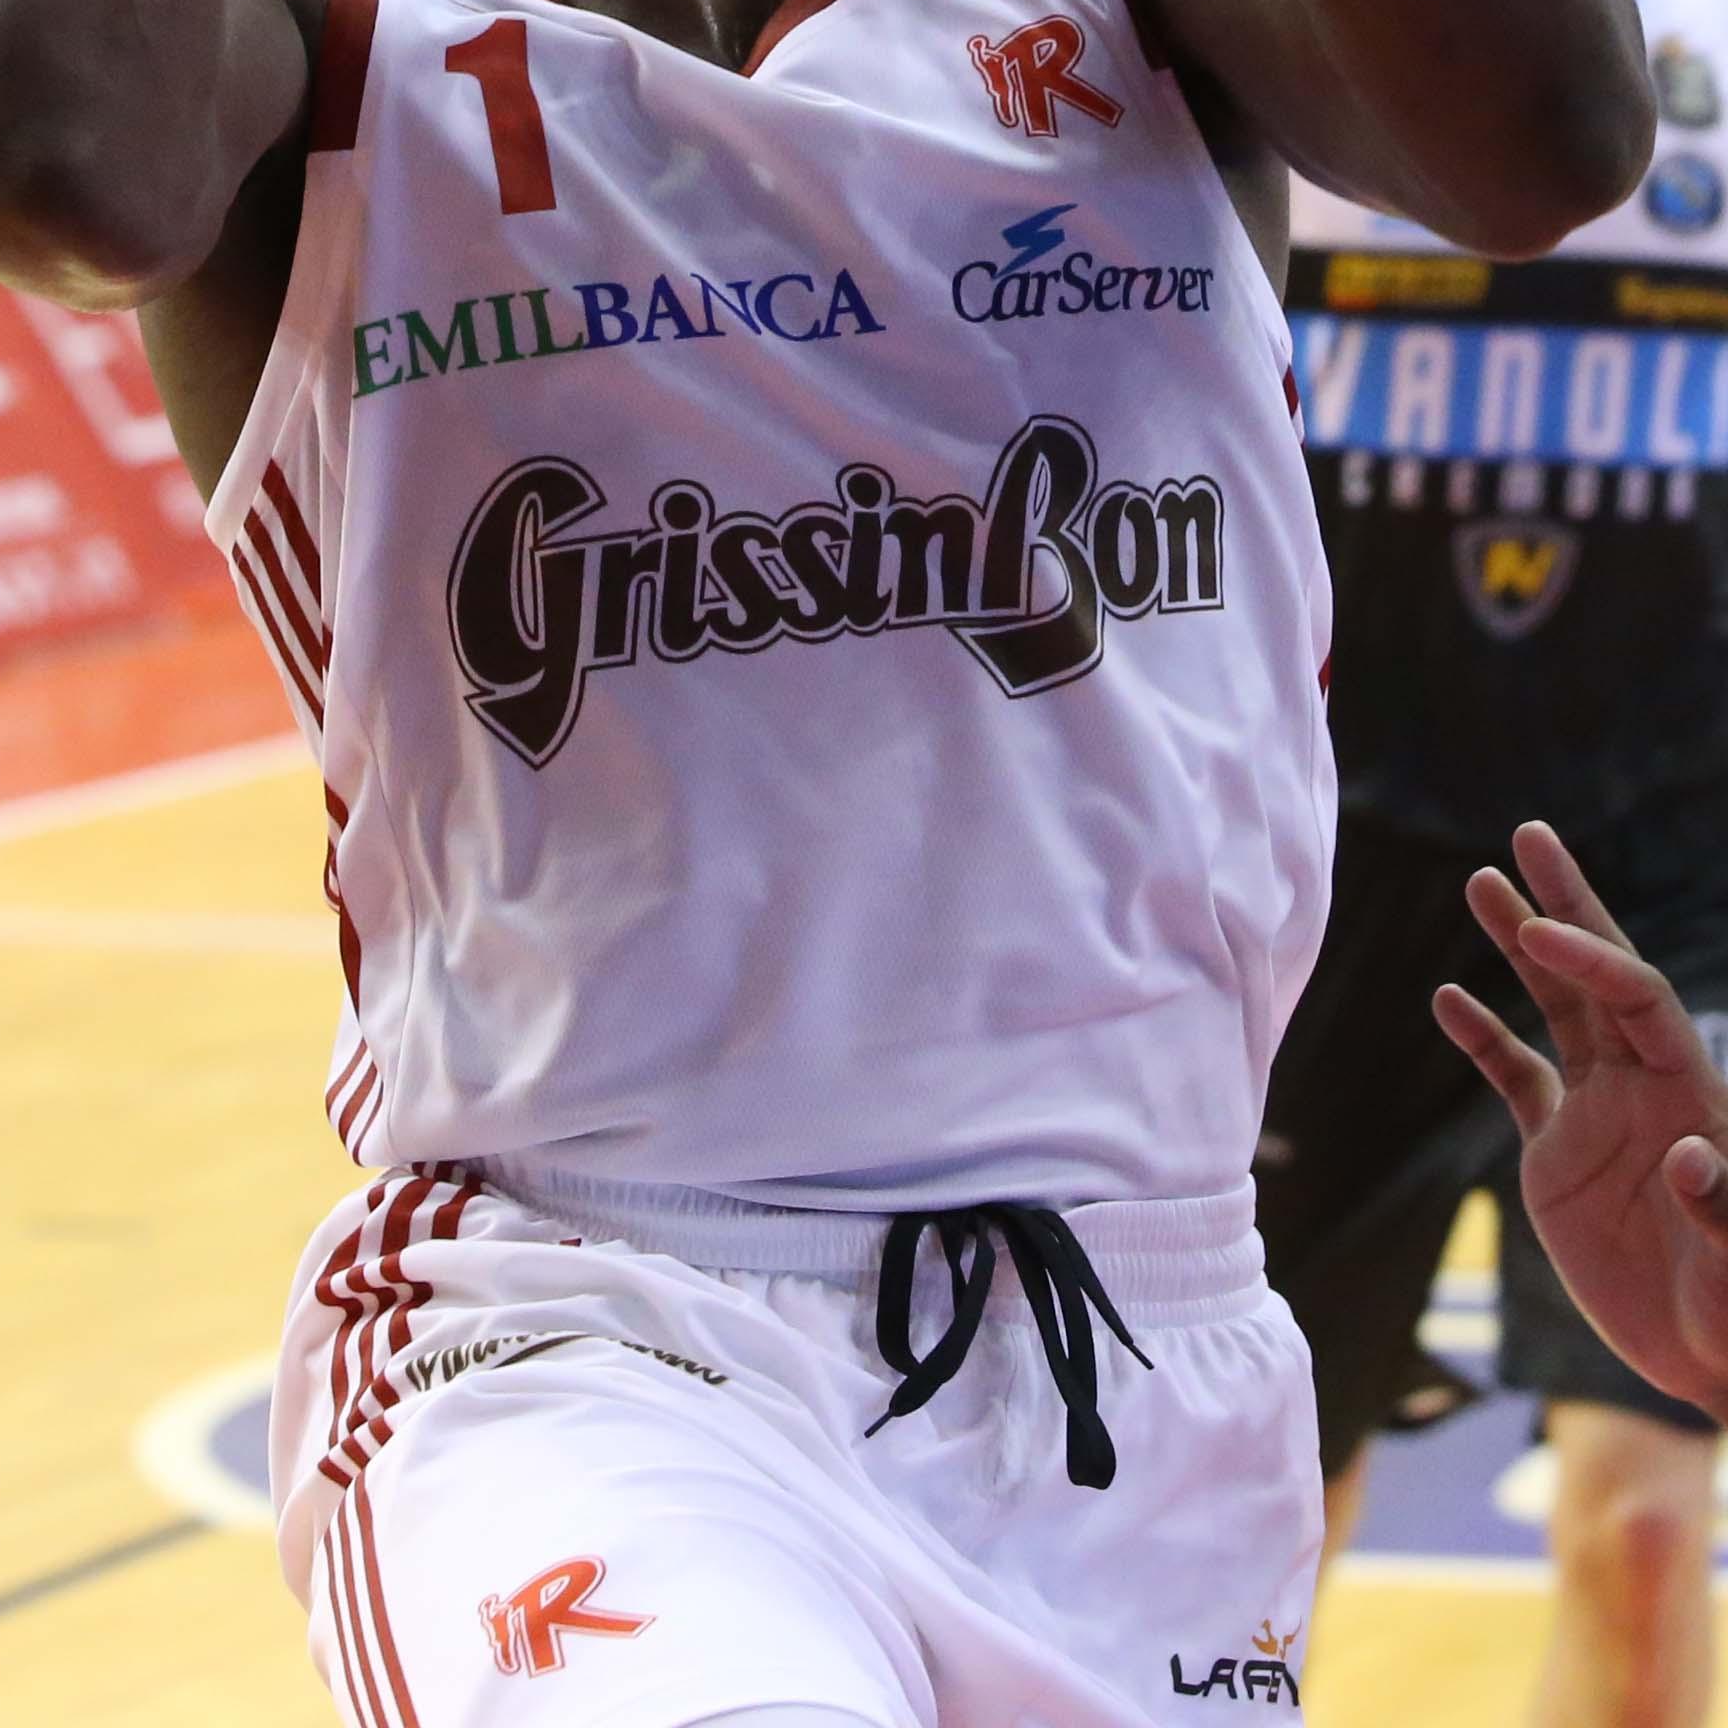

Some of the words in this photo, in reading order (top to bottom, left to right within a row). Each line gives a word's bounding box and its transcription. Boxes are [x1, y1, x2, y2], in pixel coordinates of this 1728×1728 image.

[443, 17, 557, 216] 1
[353, 267, 887, 399] EMILBANCA
[952, 251, 1214, 323] CarServer
[446, 413, 1226, 771] GrissinBon
